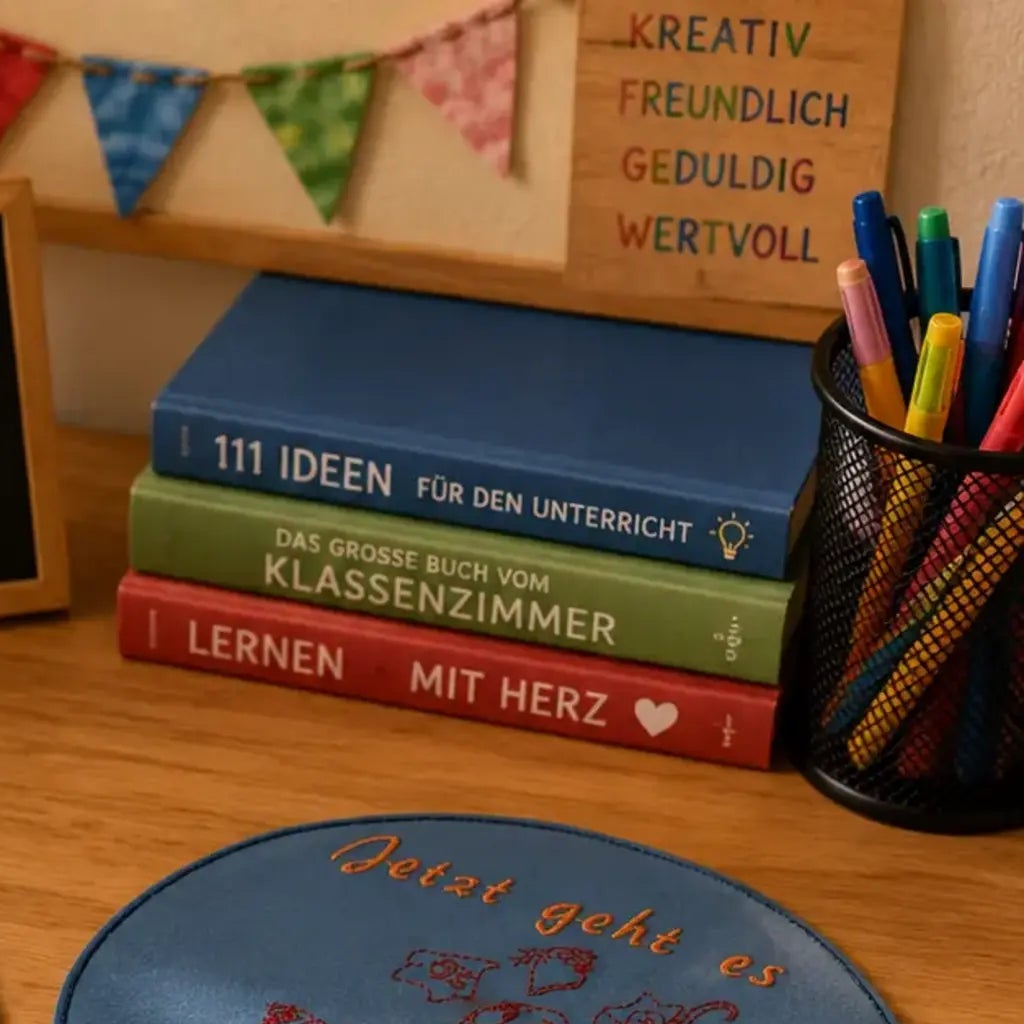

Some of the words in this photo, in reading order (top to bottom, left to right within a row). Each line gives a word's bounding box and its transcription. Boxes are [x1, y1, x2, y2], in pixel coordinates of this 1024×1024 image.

[629, 13, 811, 58] KREATIV
[619, 79, 849, 128] FREUNDLICH
[622, 147, 815, 194] GEDULDIG
[617, 213, 819, 263] WERTVOLL
[214, 434, 263, 476] 111
[280, 445, 393, 498] IDEEN
[416, 474, 464, 505] FÜR
[472, 486, 523, 516] DEN
[532, 499, 693, 545] UNTERRICHT
[276, 527, 321, 554] DAS
[328, 537, 418, 571] GROSSE
[426, 555, 488, 584] BUCH
[497, 567, 550, 595] VOM
[264, 552, 616, 647] KLASSENZIMMER
[188, 618, 345, 682] LERNEN
[410, 659, 485, 704] MIT
[499, 676, 609, 729] HERZ
[330, 834, 517, 904] Jetzt
[534, 901, 682, 955] geht
[719, 950, 786, 988] es
